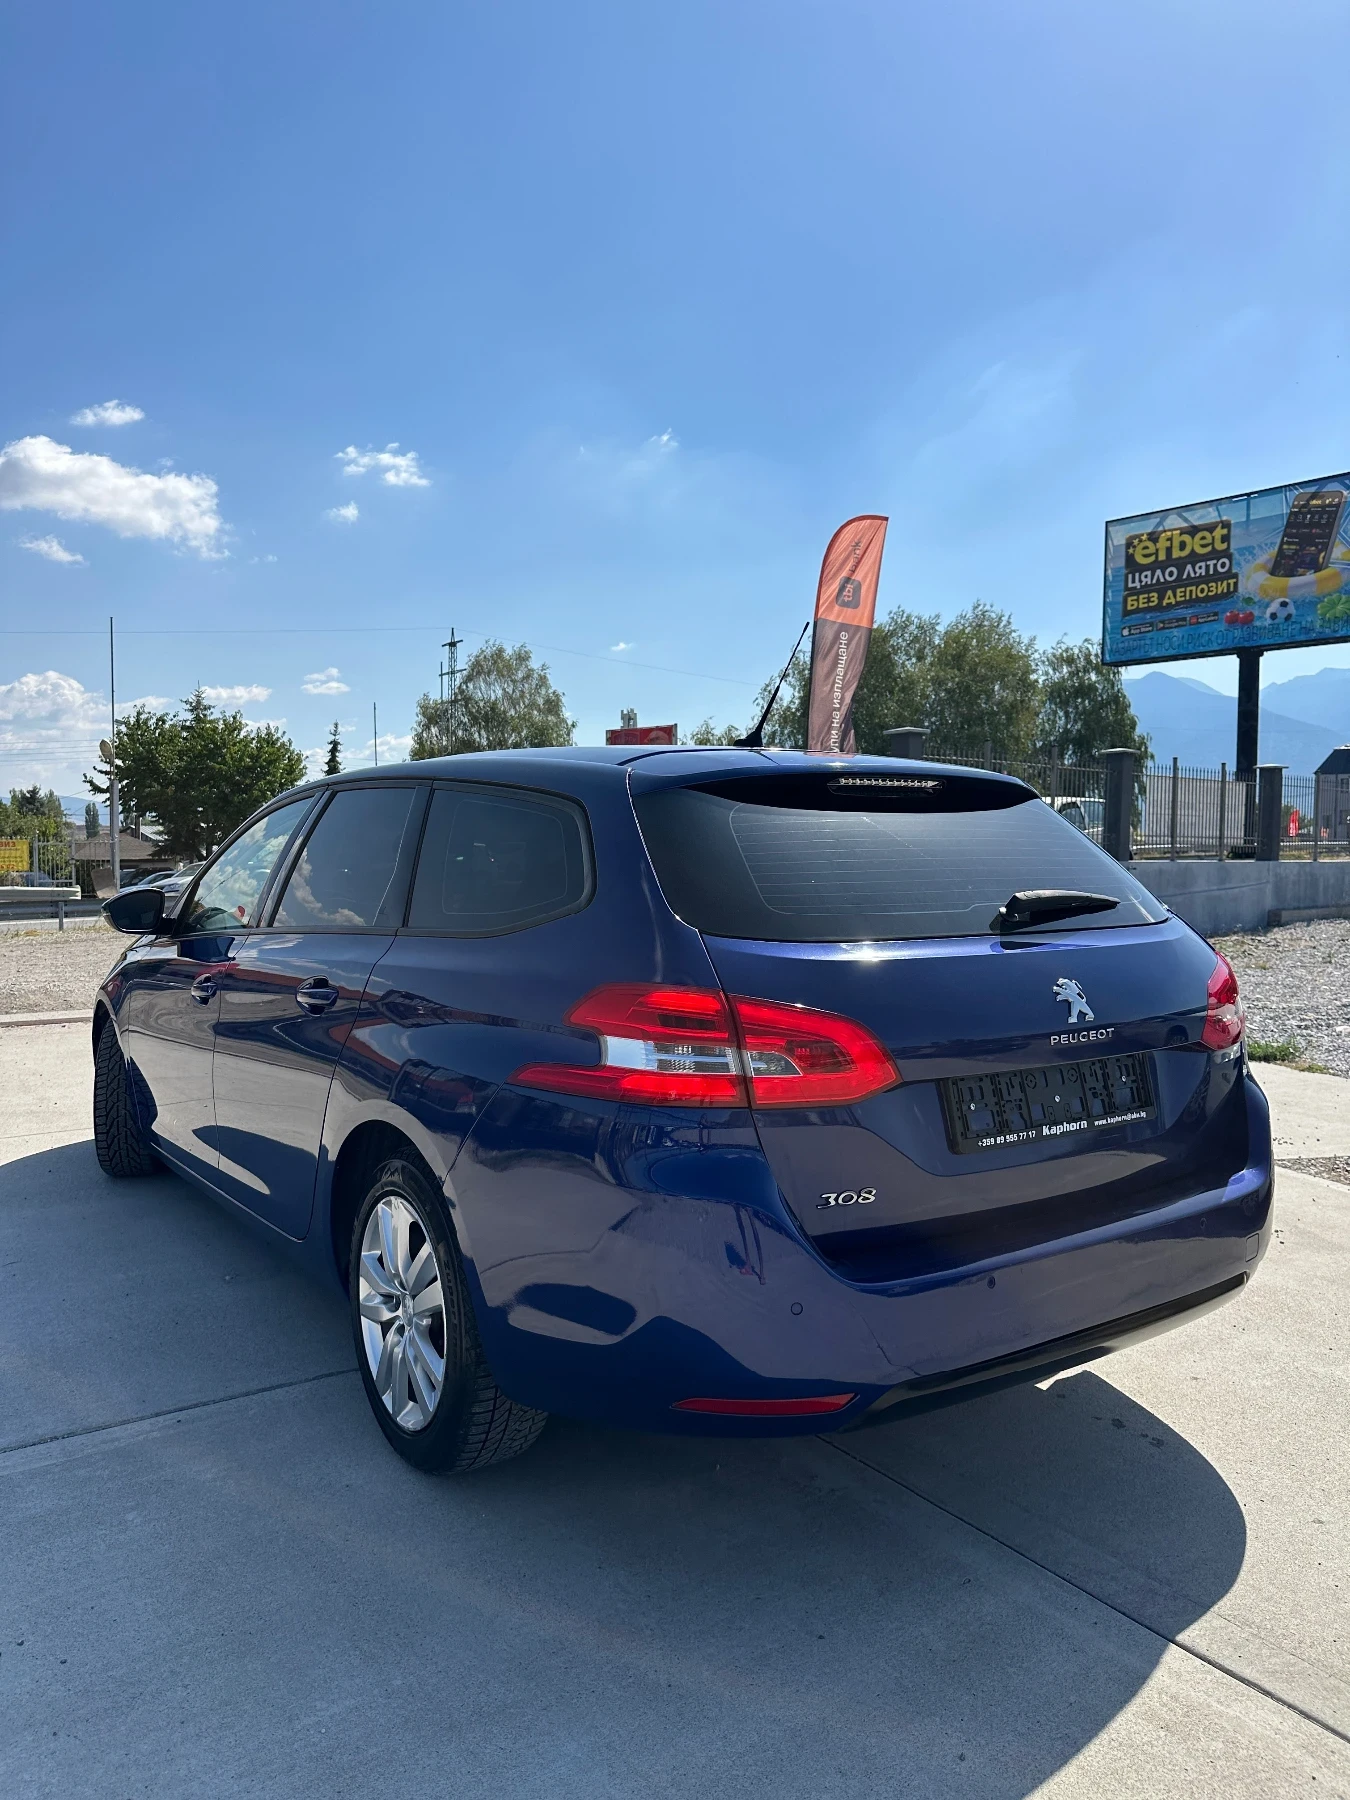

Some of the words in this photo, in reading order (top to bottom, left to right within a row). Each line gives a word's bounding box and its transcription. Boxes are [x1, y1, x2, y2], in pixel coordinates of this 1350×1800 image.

[1134, 523, 1228, 565] efbet
[1127, 566, 1178, 589] ЦЯЛО
[1182, 557, 1230, 580] ЛЯТО
[843, 583, 854, 602] tbi
[1126, 591, 1159, 611] БЕЗ
[1162, 578, 1237, 607] ДЕПОЗИТ
[1187, 630, 1214, 649] РИСК
[833, 631, 849, 708] изплащане
[831, 710, 841, 727] на
[1050, 1027, 1115, 1046] PEUGEOT
[977, 1133, 995, 1147] +359
[1028, 1130, 1036, 1139] 17
[1042, 1120, 1088, 1136] Kaphorn
[817, 1187, 877, 1209] 308
